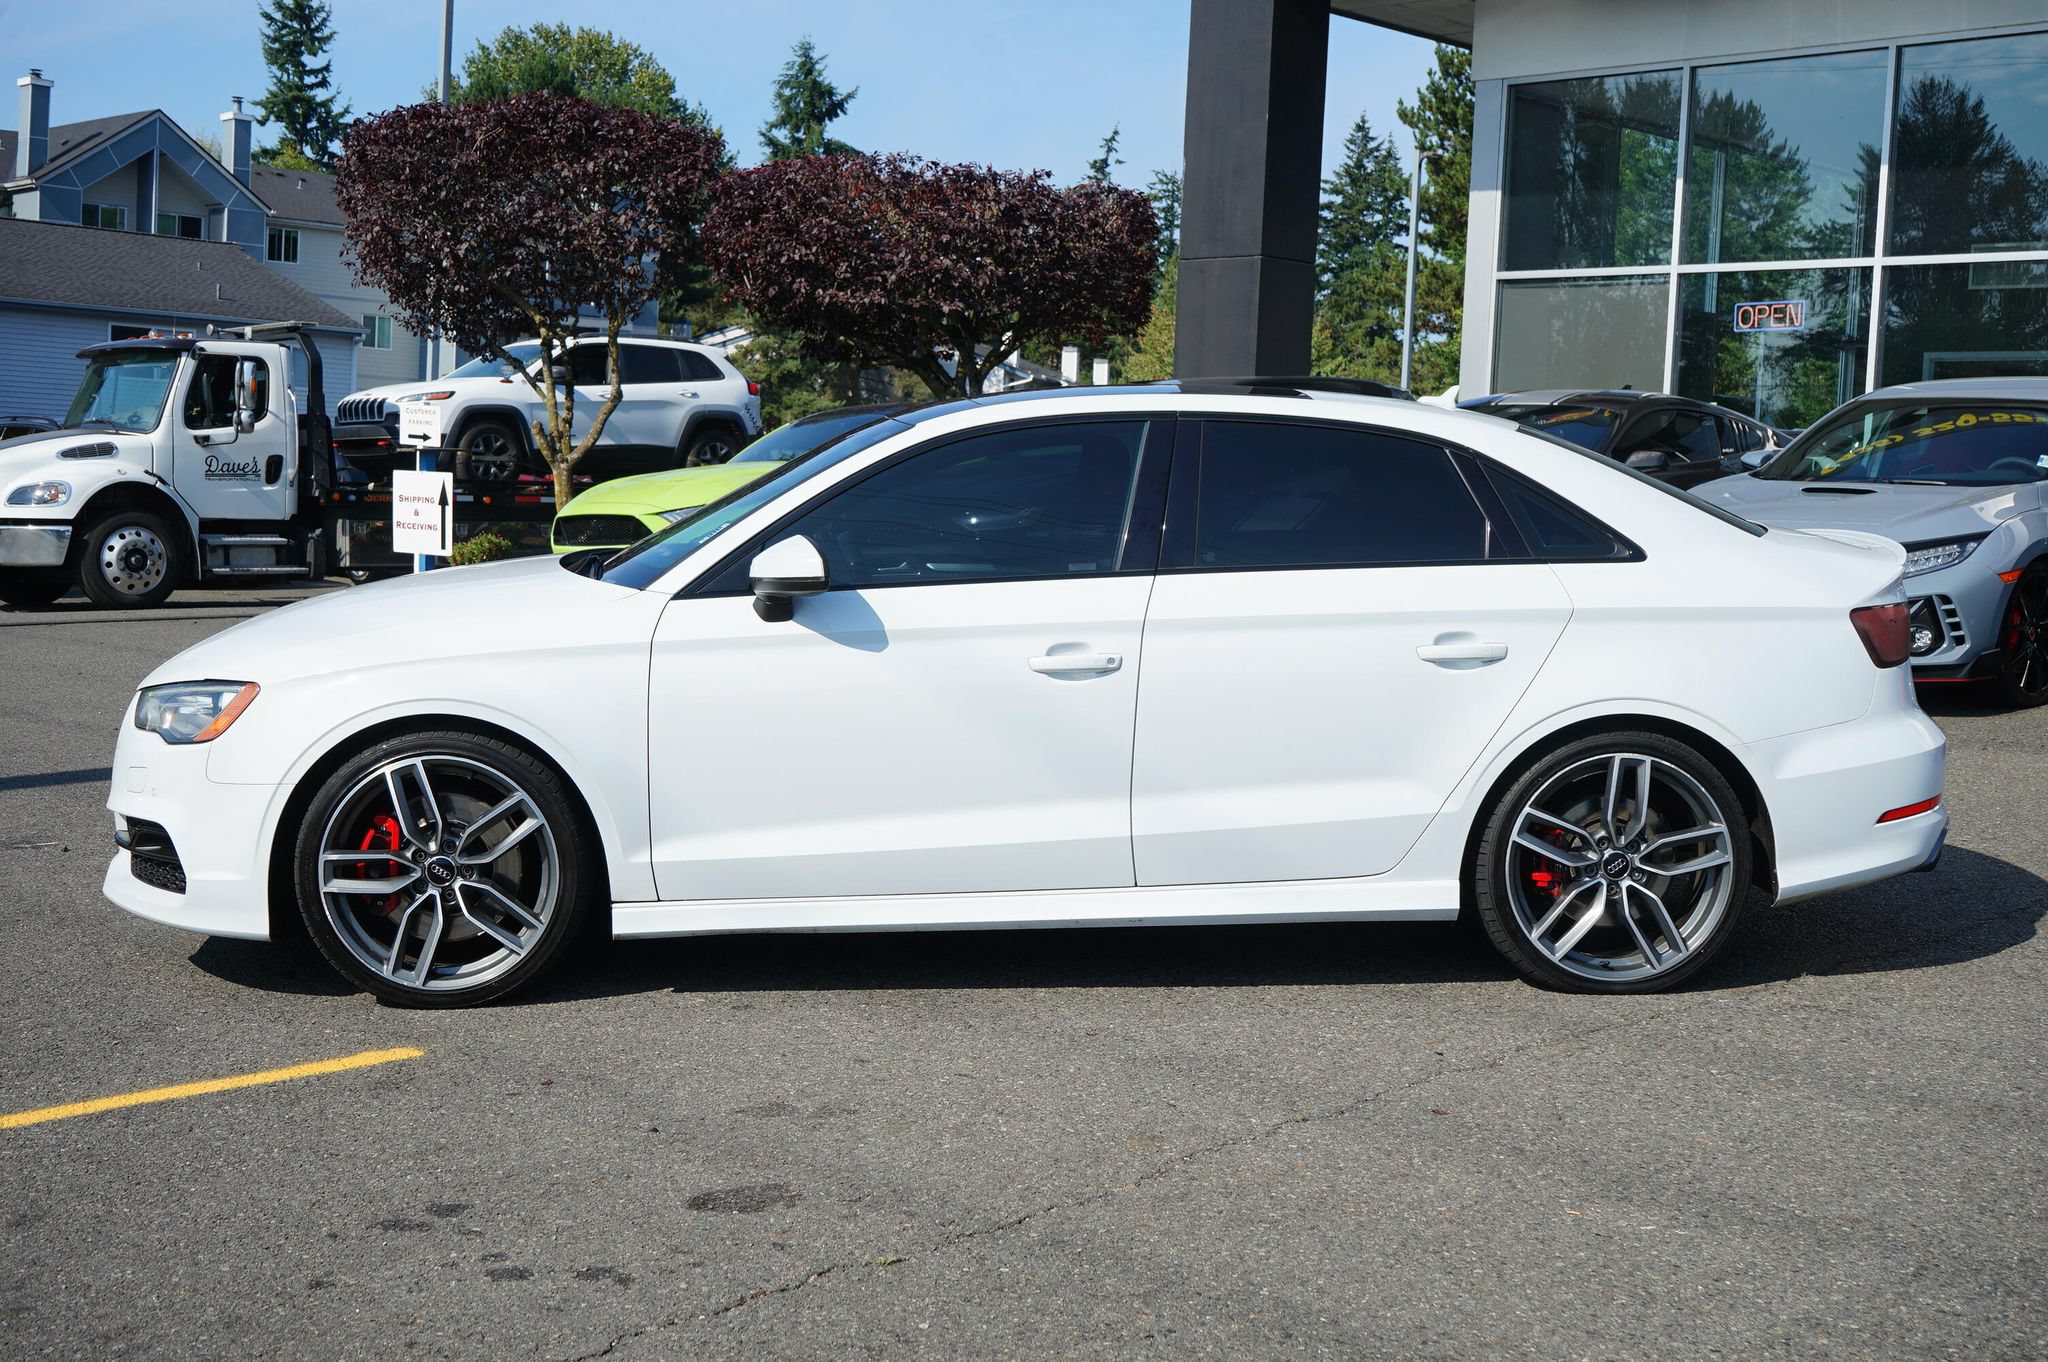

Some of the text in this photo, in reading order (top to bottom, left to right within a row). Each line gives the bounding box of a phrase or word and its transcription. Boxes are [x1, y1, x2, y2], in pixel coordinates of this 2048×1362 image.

[1738, 303, 1802, 328] OPEN
[204, 455, 261, 473] Dave's
[398, 494, 435, 504] SHIPPING
[413, 508, 420, 517] &
[396, 520, 438, 531] RECEIVING
